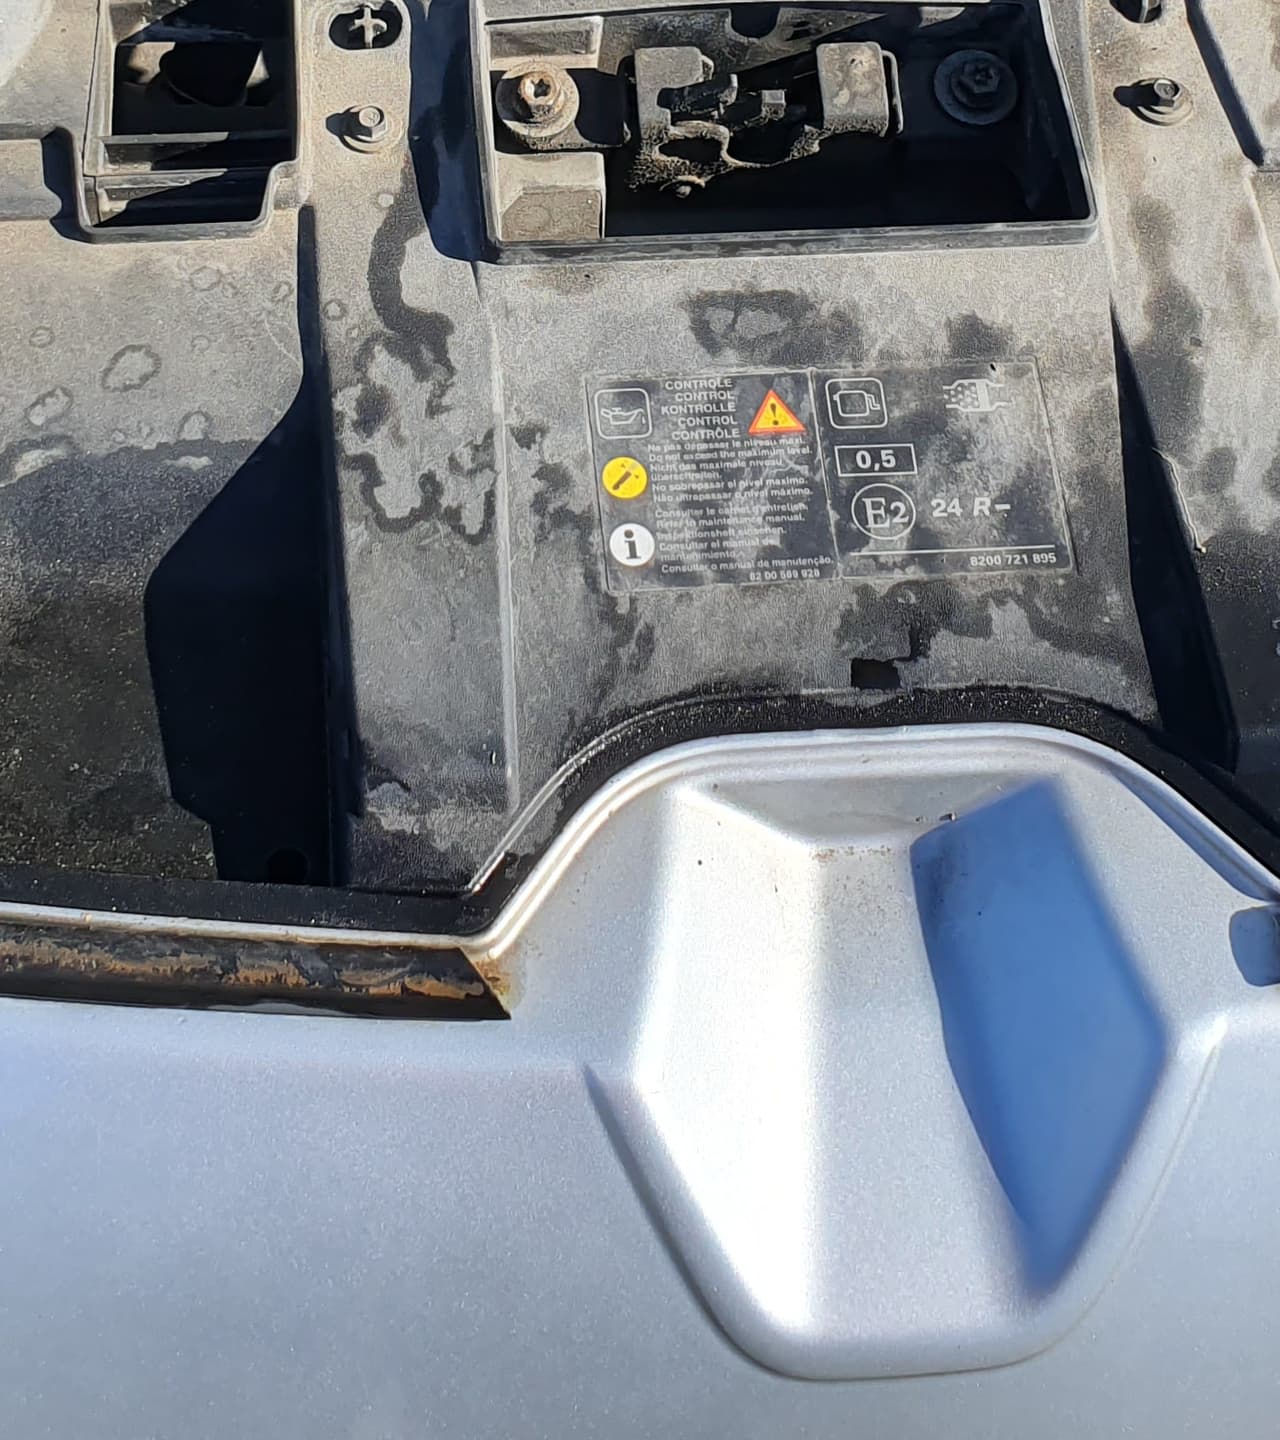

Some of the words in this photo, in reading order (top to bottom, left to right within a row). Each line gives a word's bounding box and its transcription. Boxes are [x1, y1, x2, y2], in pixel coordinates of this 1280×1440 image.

[675, 391, 735, 401] CONTROL
[661, 402, 736, 415] KONTROLLE
[678, 415, 738, 427] CONTROL
[671, 427, 740, 440] CONTRÔLE
[720, 450, 736, 459] the
[855, 449, 896, 471] 0,5
[862, 497, 910, 529] E2
[931, 498, 963, 518] 24
[970, 556, 1001, 567] 8200
[1005, 556, 1028, 566] 721
